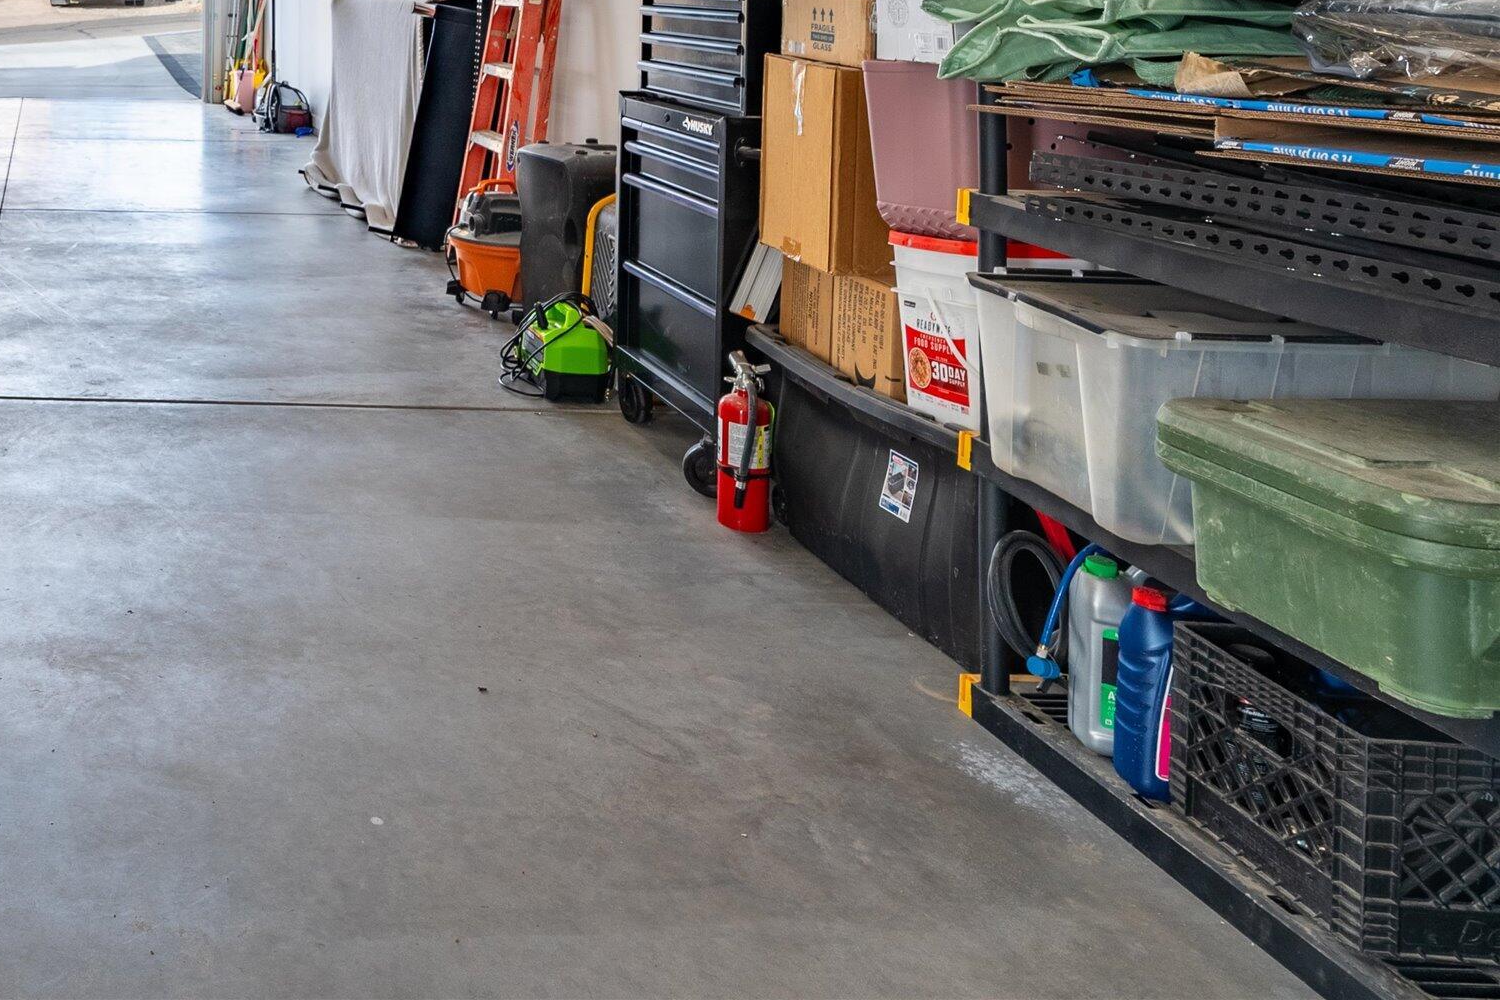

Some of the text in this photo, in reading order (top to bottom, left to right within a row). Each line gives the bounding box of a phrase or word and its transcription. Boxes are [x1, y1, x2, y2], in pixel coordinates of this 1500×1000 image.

[811, 23, 835, 33] FRAGILE
[812, 42, 832, 52] GLASS
[690, 119, 714, 136] HUSKY
[913, 336, 929, 349] FOOD
[931, 360, 966, 383] 30 DAY
[949, 378, 966, 388] SUPPLY
